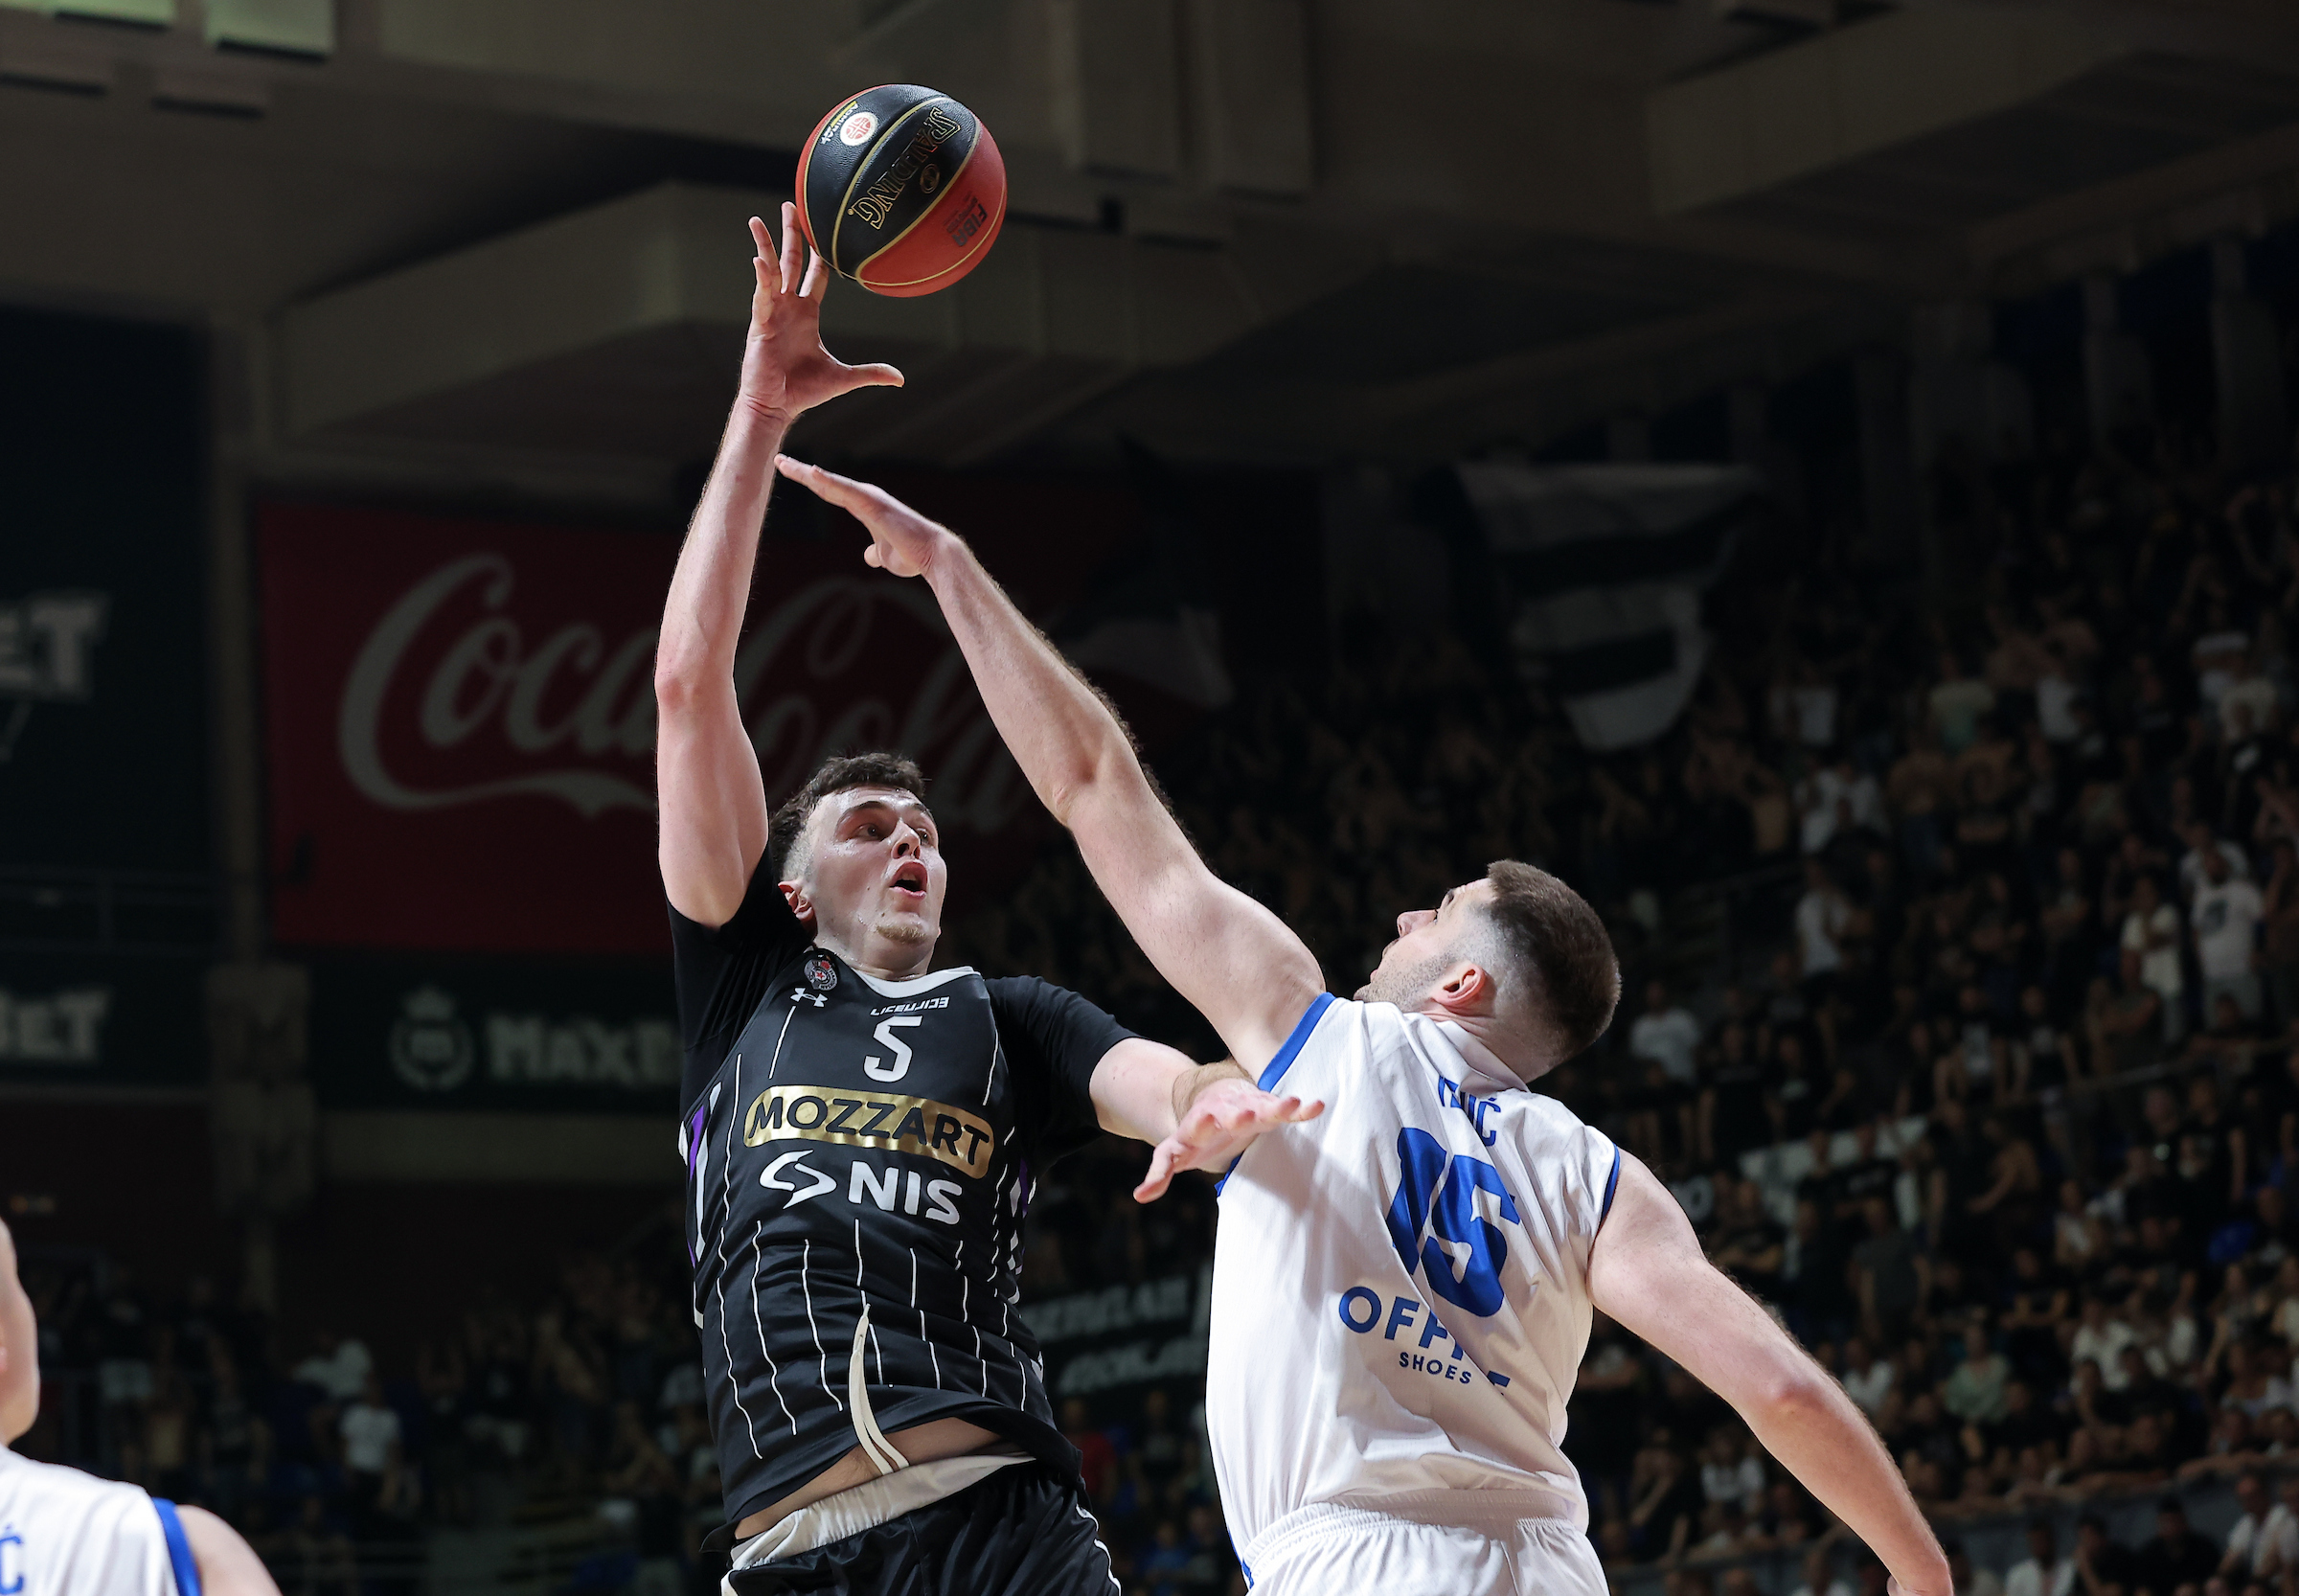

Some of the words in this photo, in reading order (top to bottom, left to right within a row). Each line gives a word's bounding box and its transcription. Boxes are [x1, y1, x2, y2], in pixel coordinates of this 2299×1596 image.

[848, 106, 962, 231] SPALDING
[951, 203, 989, 247] FIBA
[863, 1015, 922, 1083] 5
[749, 1095, 990, 1166] MOZZART
[848, 1159, 963, 1226] NIS
[1399, 1351, 1472, 1385] SHOES
